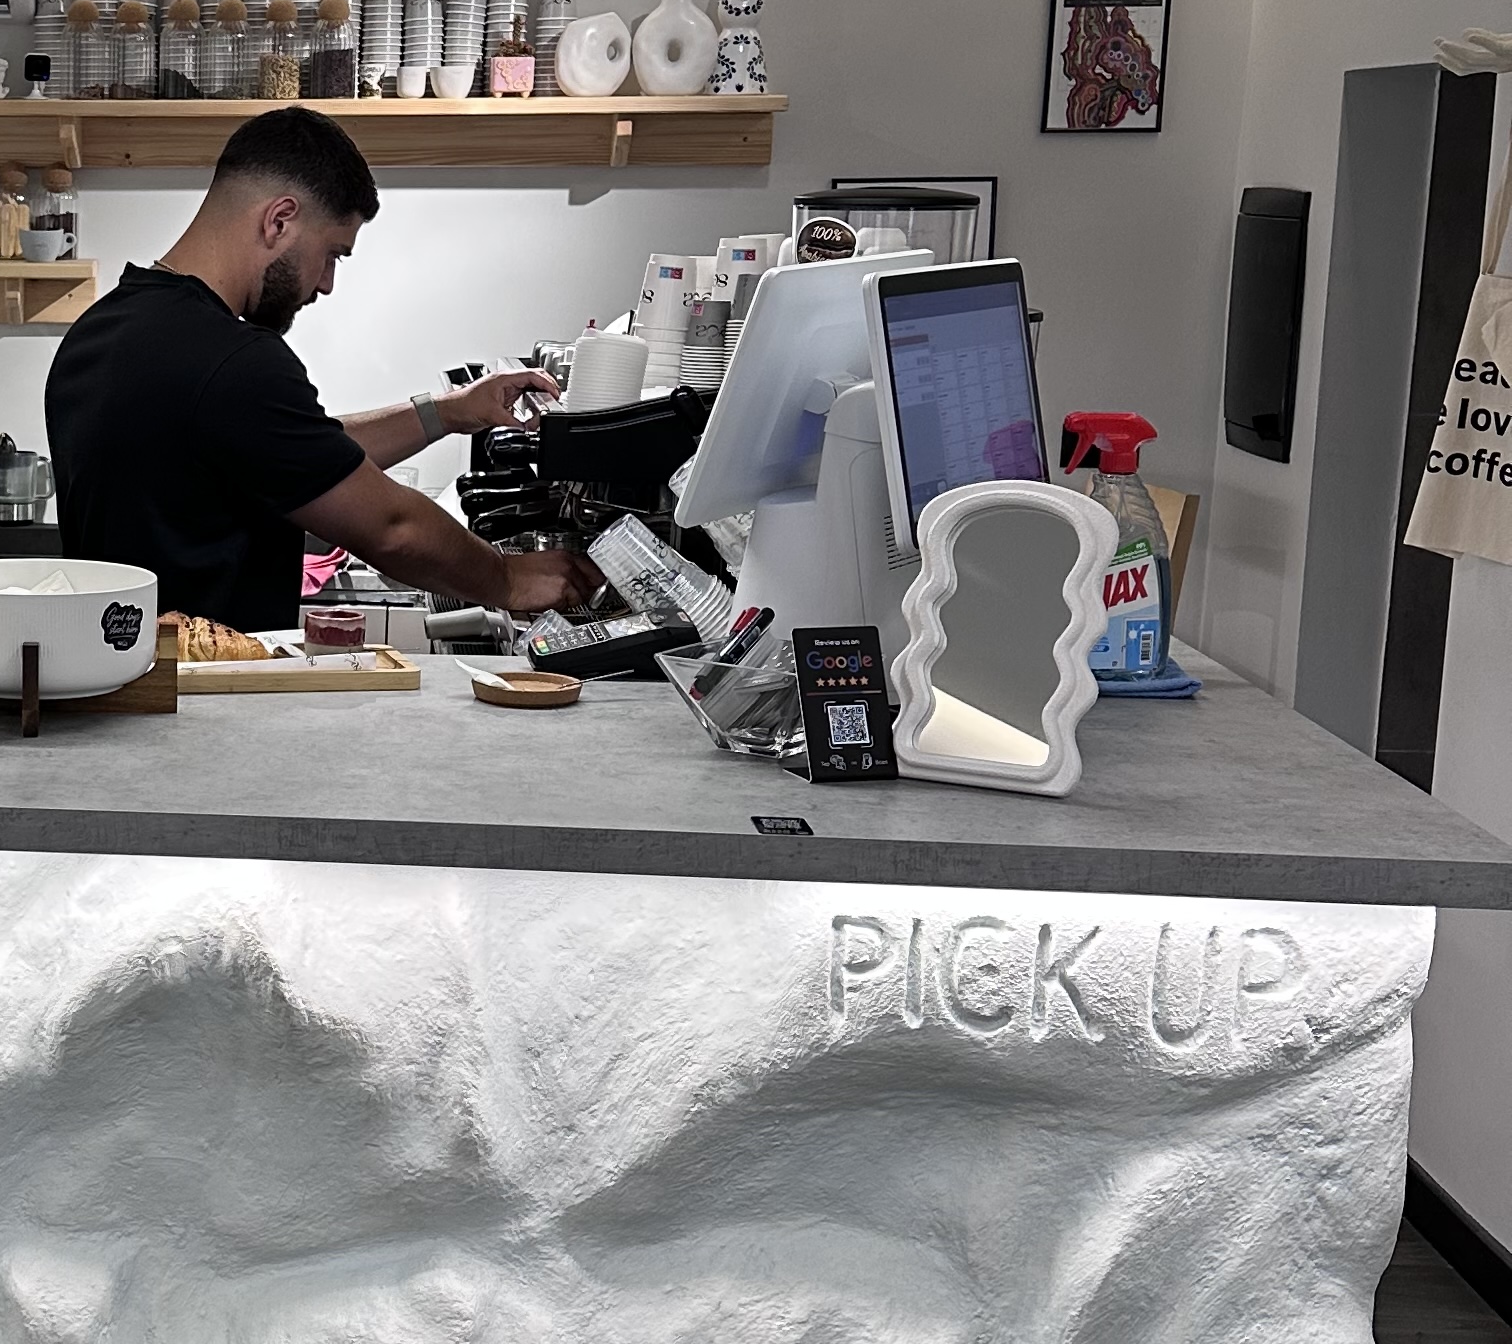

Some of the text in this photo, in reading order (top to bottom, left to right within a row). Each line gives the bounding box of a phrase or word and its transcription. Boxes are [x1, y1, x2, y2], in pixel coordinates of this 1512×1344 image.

[811, 226, 844, 242] 100%
[806, 650, 873, 673] Google
[828, 914, 1304, 1052] PICK UP
